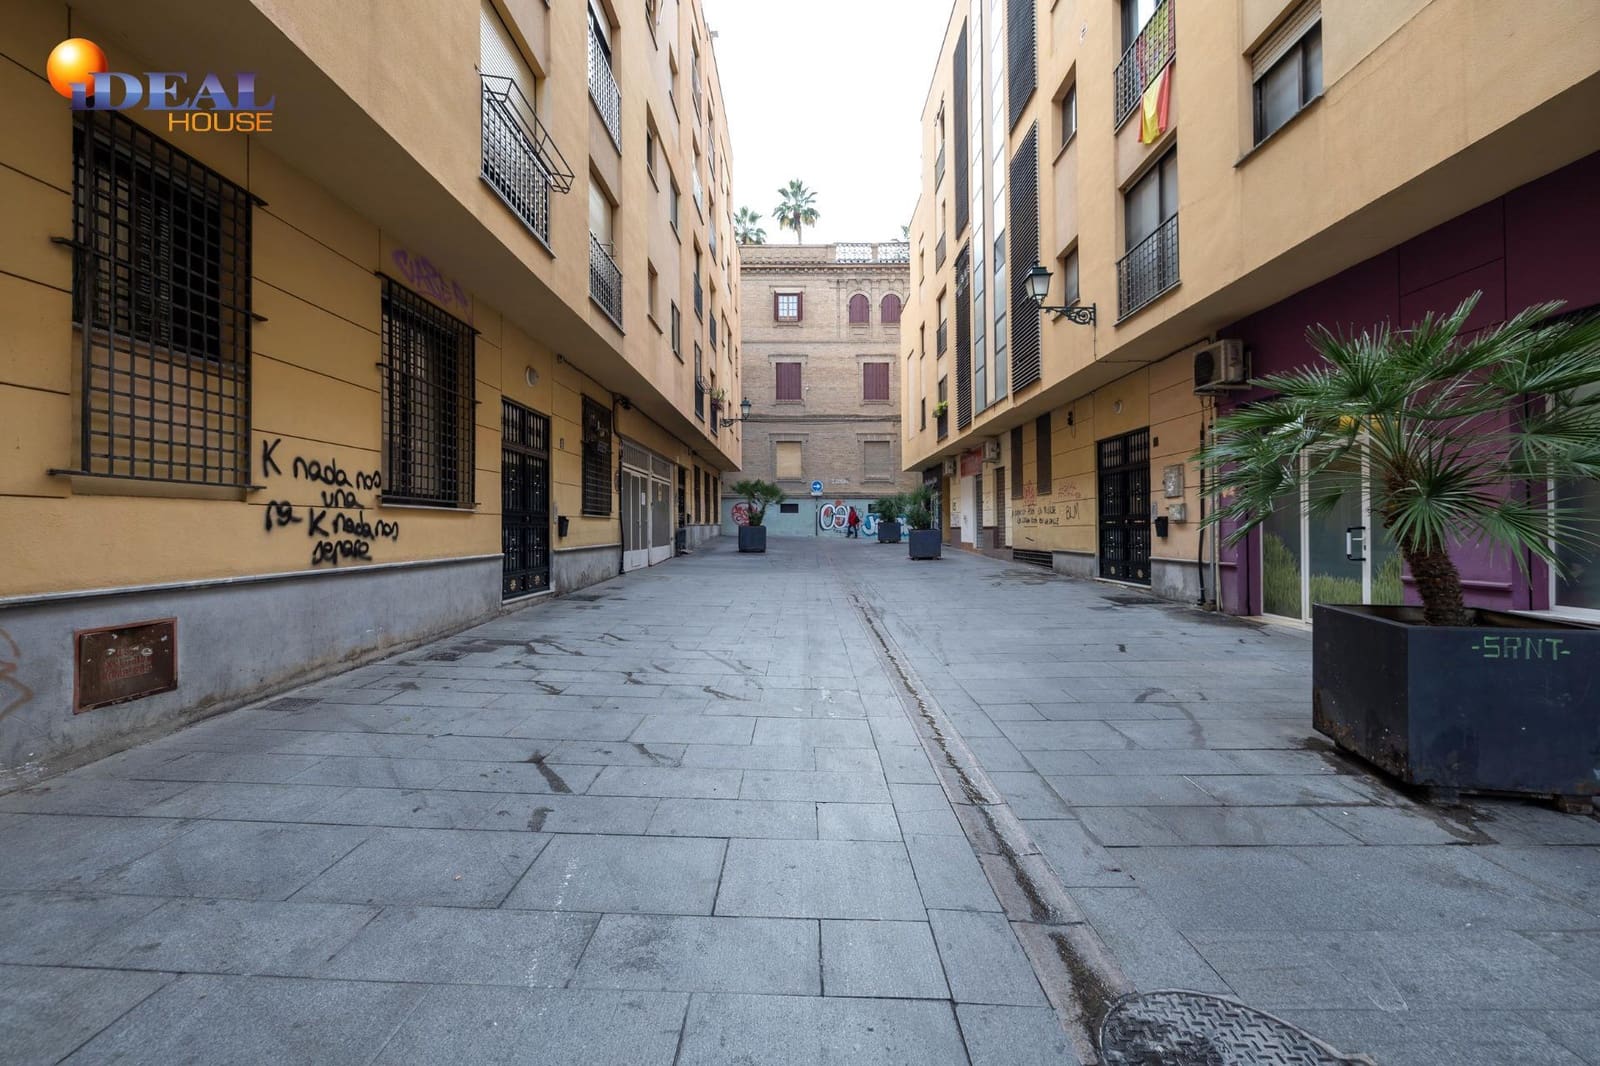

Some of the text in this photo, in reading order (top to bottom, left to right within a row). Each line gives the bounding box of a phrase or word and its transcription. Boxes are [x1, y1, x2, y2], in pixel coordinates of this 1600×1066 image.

[262, 438, 382, 490] K nada nos
[320, 488, 364, 509] una
[308, 507, 329, 537] K
[332, 510, 375, 540] nada
